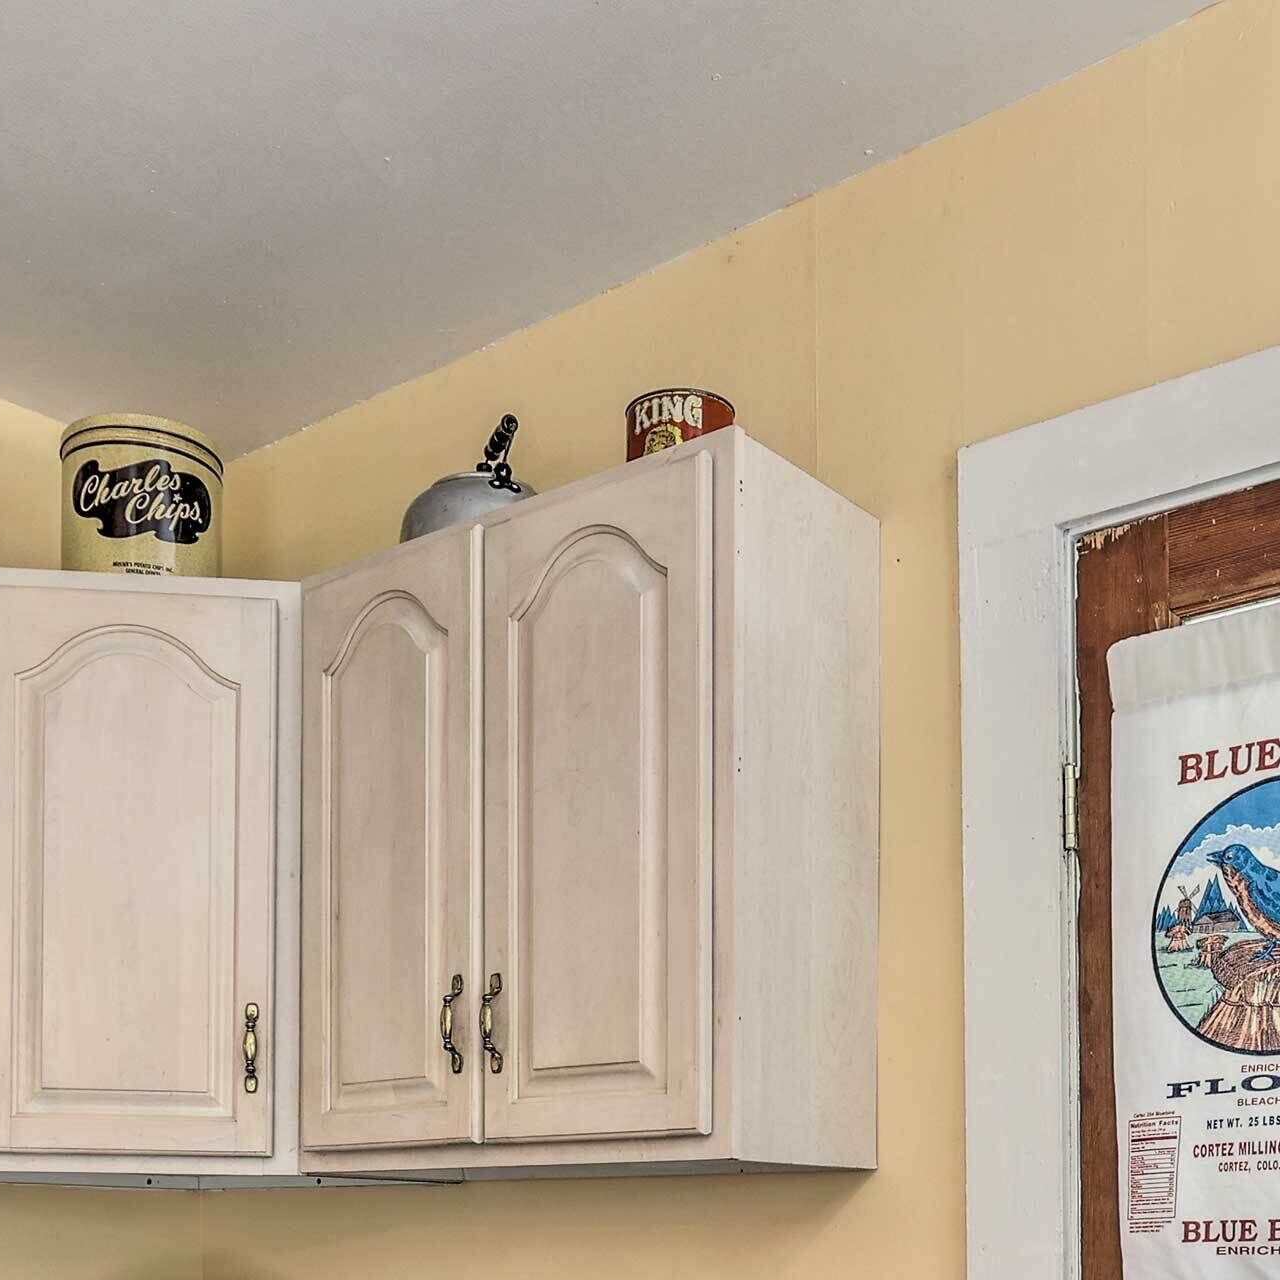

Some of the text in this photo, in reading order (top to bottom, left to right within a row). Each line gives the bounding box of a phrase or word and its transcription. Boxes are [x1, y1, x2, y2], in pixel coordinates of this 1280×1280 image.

[633, 395, 703, 435] KING
[79, 464, 181, 512] Charles
[1207, 1119, 1223, 1129] NET
[1249, 1117, 1258, 1126] 25
[1193, 1143, 1234, 1158] CORTEZ
[1182, 1220, 1258, 1243] BLUE
